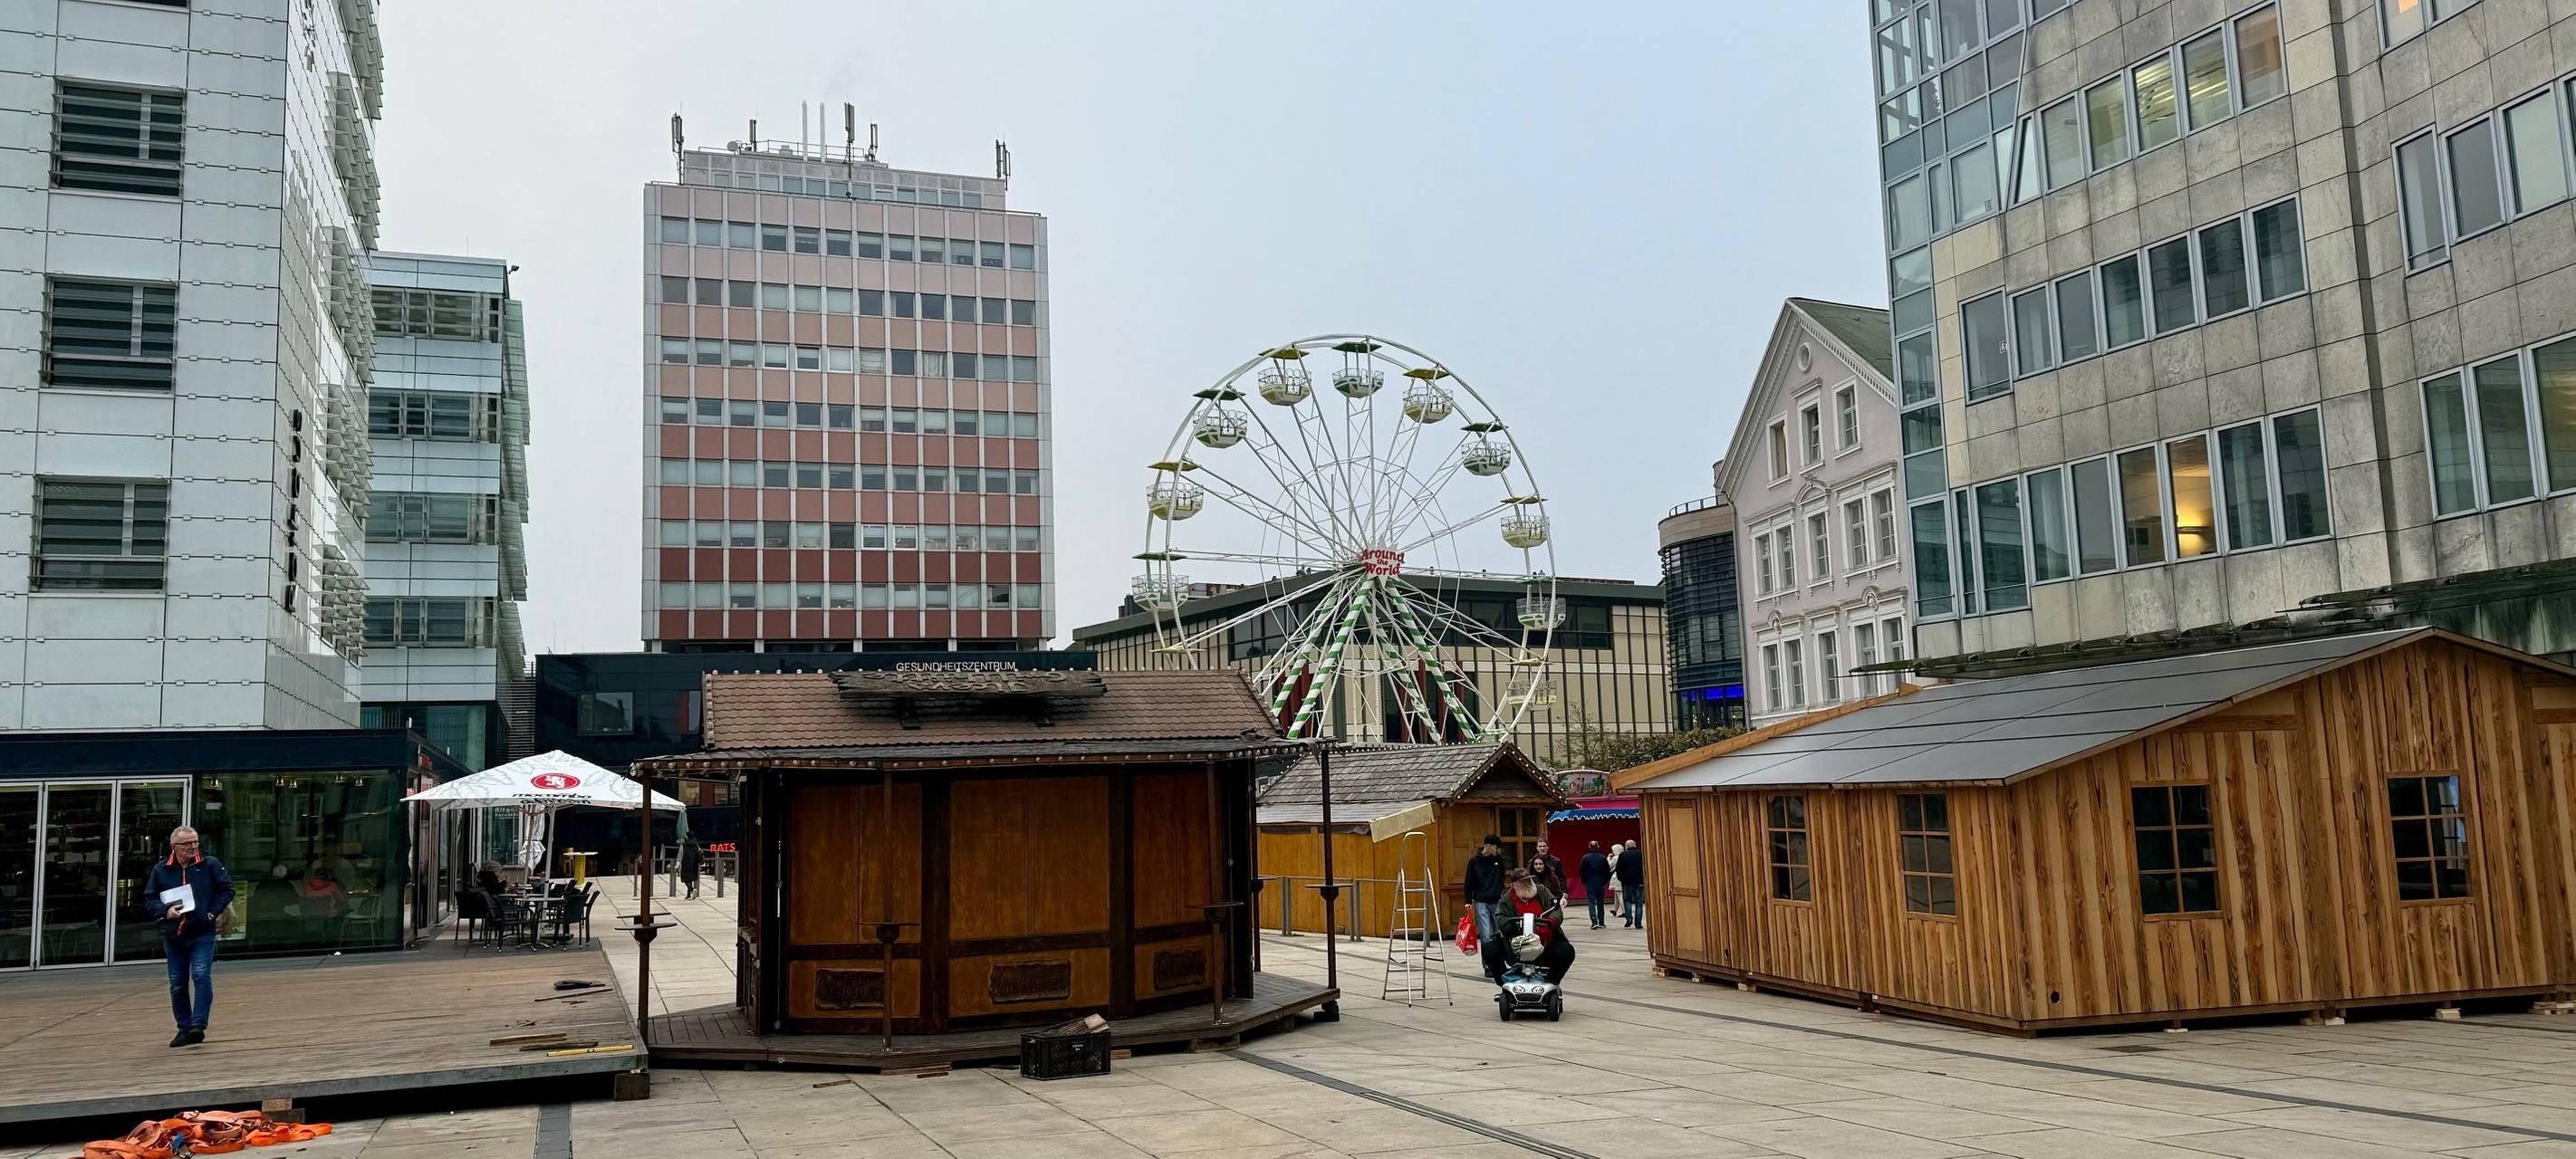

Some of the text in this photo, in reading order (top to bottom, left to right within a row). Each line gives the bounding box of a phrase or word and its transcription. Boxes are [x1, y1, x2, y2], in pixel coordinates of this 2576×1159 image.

[1361, 549, 1405, 563] Around
[1364, 561, 1401, 576] World
[896, 661, 1016, 672] GESUNDHEITSZENTRUM
[710, 842, 736, 853] RATS
